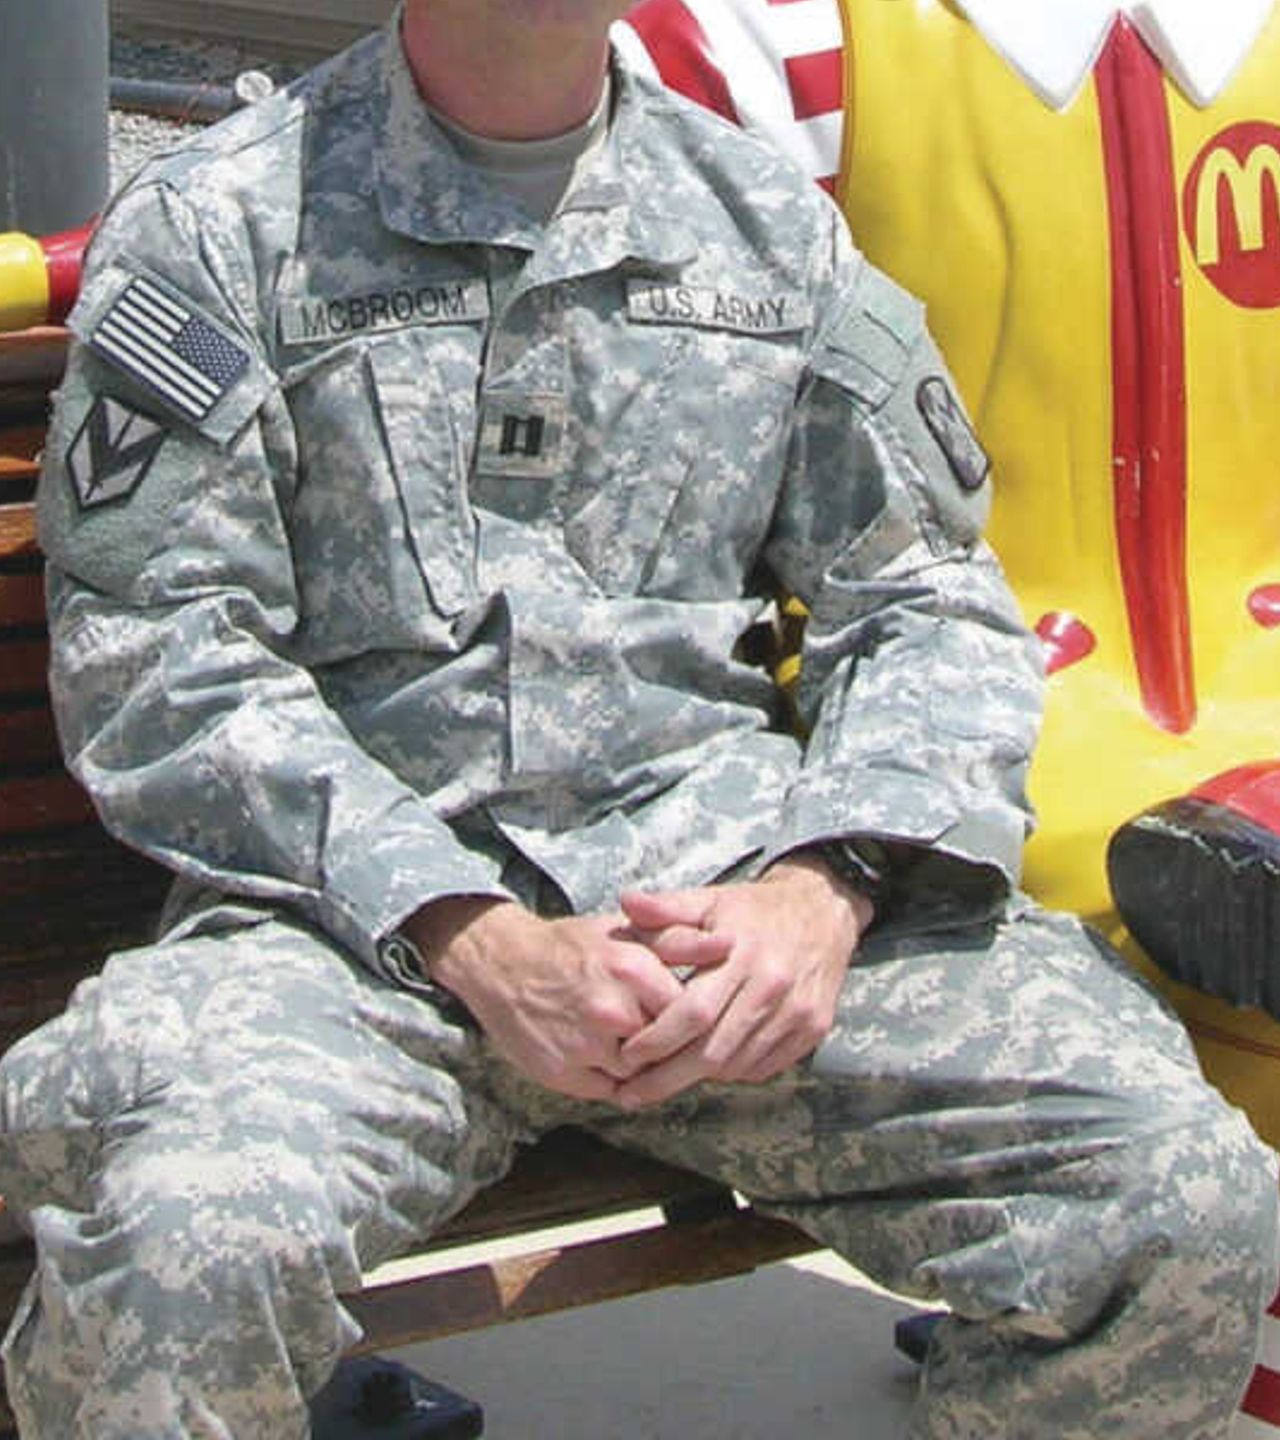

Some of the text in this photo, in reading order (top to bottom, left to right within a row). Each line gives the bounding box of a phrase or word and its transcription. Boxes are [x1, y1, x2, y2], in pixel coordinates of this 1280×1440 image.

[298, 286, 467, 337] MCBROOM
[649, 286, 786, 329] U.S. ARMY
